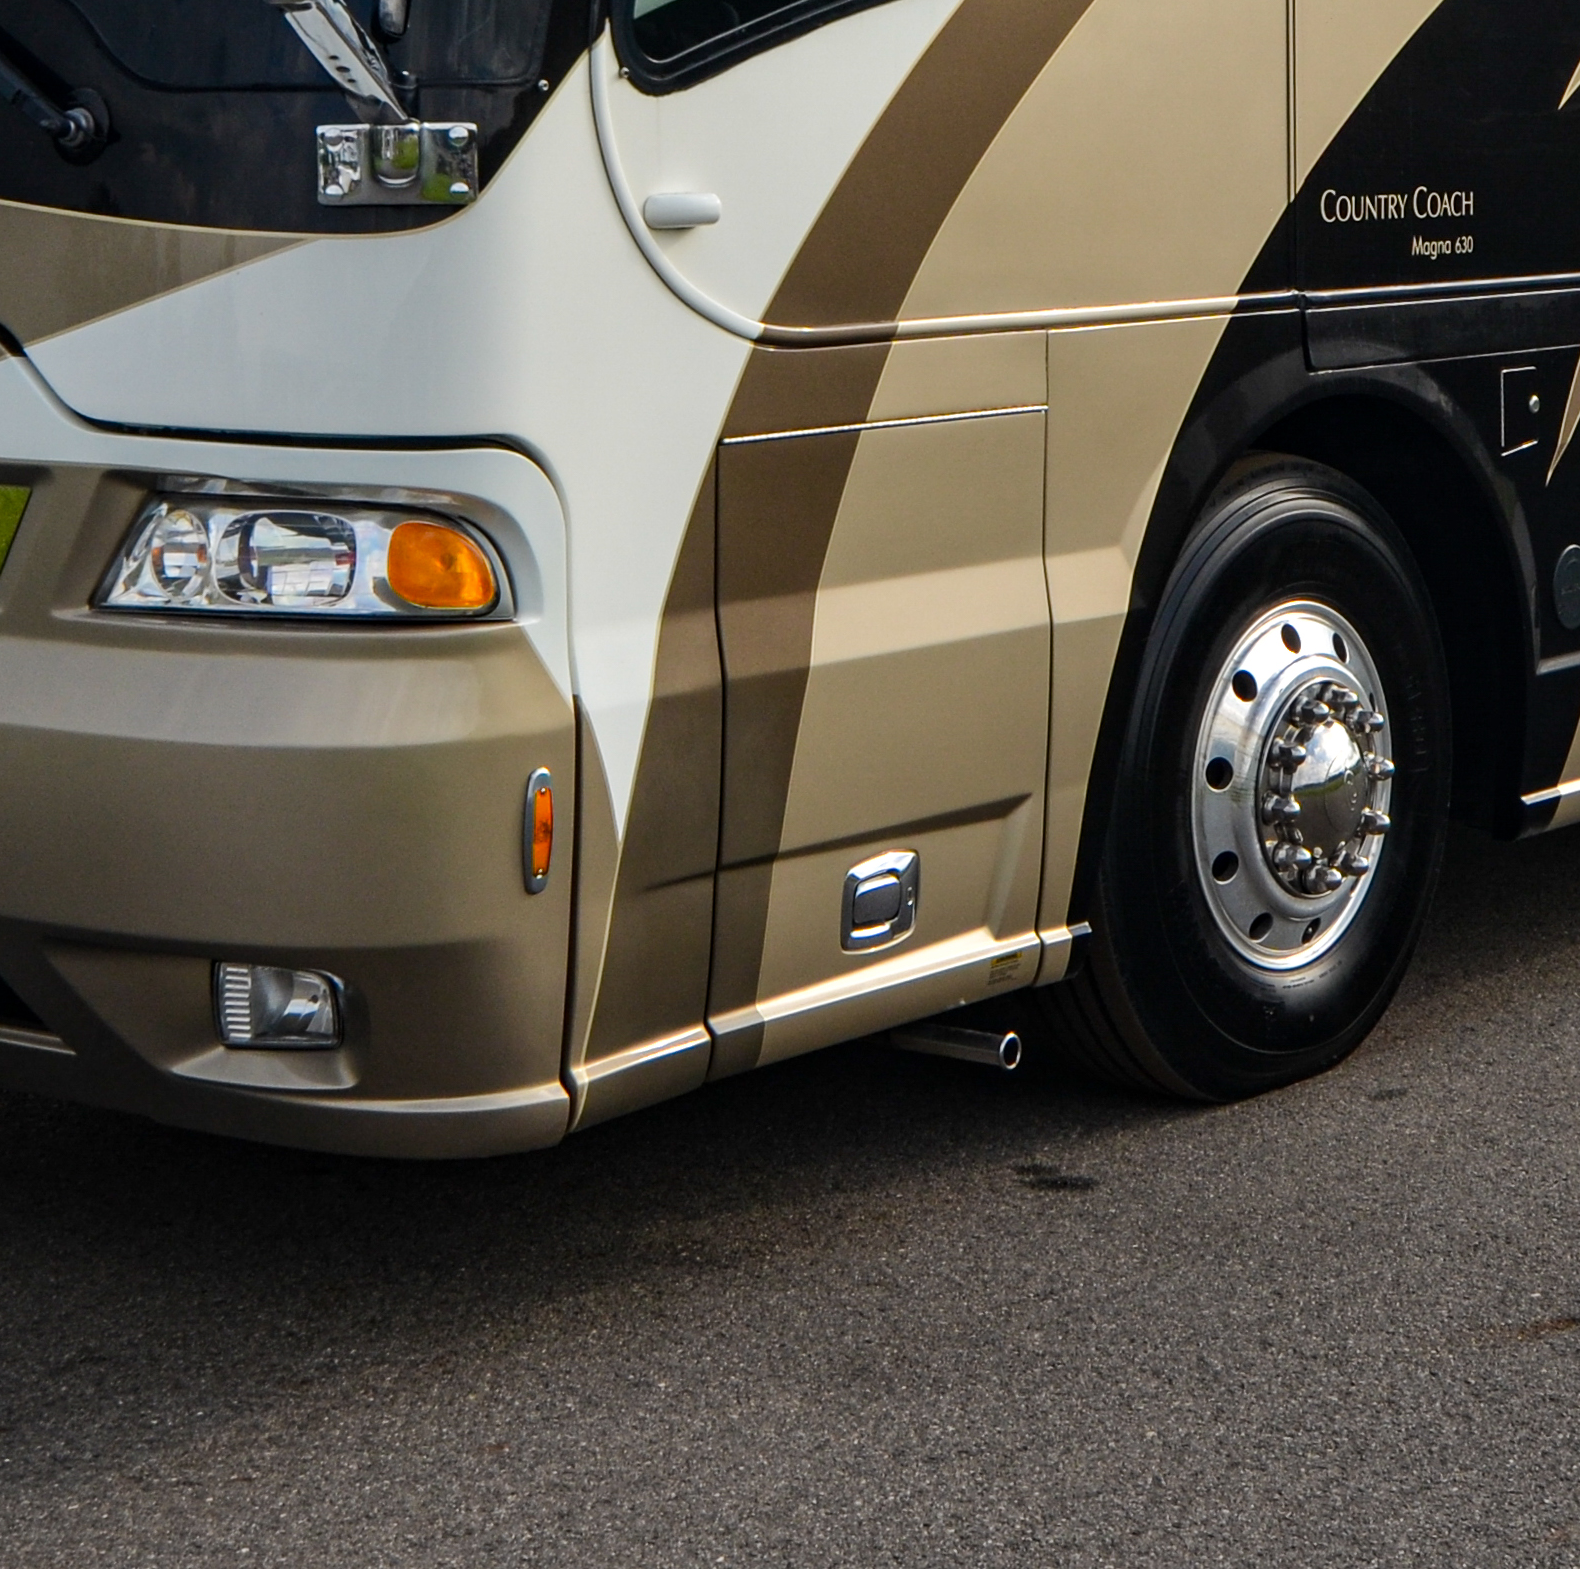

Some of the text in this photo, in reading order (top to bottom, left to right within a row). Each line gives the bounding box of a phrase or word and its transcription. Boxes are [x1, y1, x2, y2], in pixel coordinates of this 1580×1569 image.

[1320, 185, 1474, 223] COUNTRY COACH
[1411, 235, 1474, 260] Magna 630
